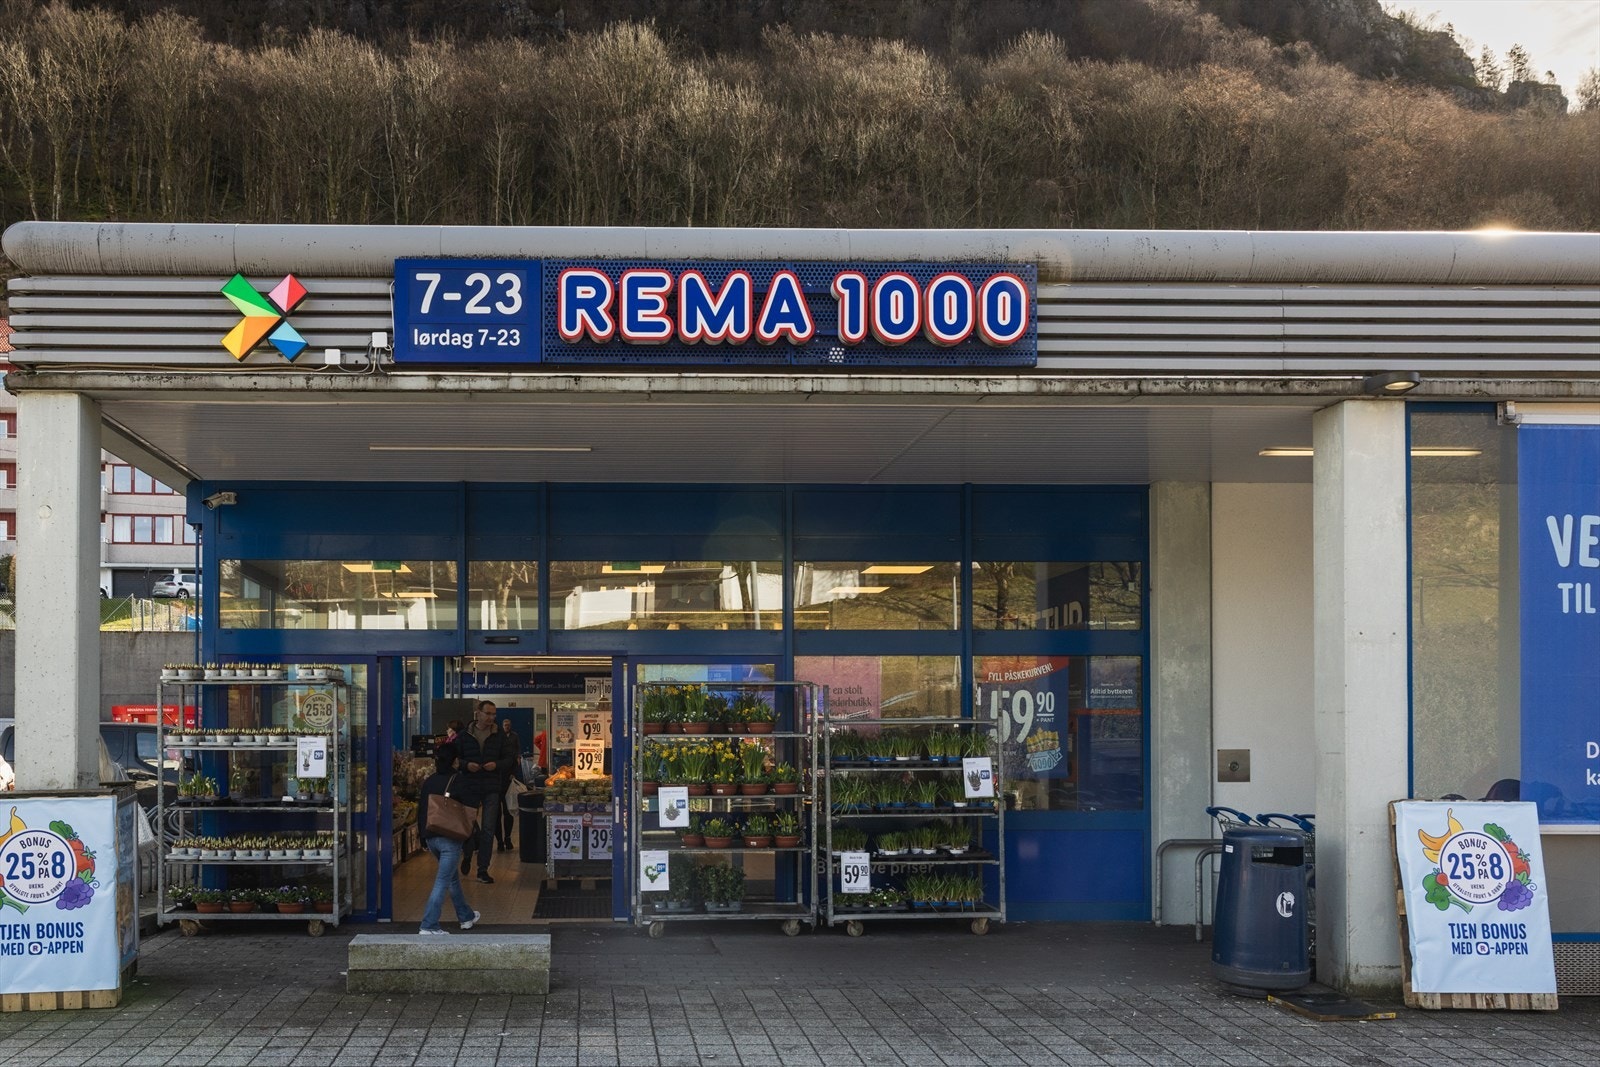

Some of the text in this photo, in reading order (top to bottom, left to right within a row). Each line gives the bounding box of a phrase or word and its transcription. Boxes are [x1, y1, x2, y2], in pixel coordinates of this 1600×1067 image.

[415, 272, 522, 315] 7-23
[558, 267, 1029, 347] REMA 1000
[414, 328, 520, 349] lørdag 7-23
[1546, 514, 1600, 568] VE
[1557, 582, 1597, 614] TIL
[988, 663, 1054, 681] FYLL PÅSKEKURVEN!
[306, 703, 319, 717] 25
[989, 689, 1055, 744] 59 90
[577, 752, 593, 771] 39
[19, 836, 52, 849] BONUS
[554, 829, 571, 849] 39
[591, 829, 608, 849] 39
[1457, 838, 1488, 850] BONUS
[6, 852, 34, 880] 25
[51, 851, 66, 879] 8
[844, 864, 868, 884] 59 90
[1447, 853, 1475, 880] 25
[1488, 853, 1504, 880] 8
[0, 922, 84, 940] TJEN BONUS
[1447, 923, 1527, 940] TJEN BONUS
[0, 942, 24, 956] MED
[1451, 941, 1473, 955] MED
